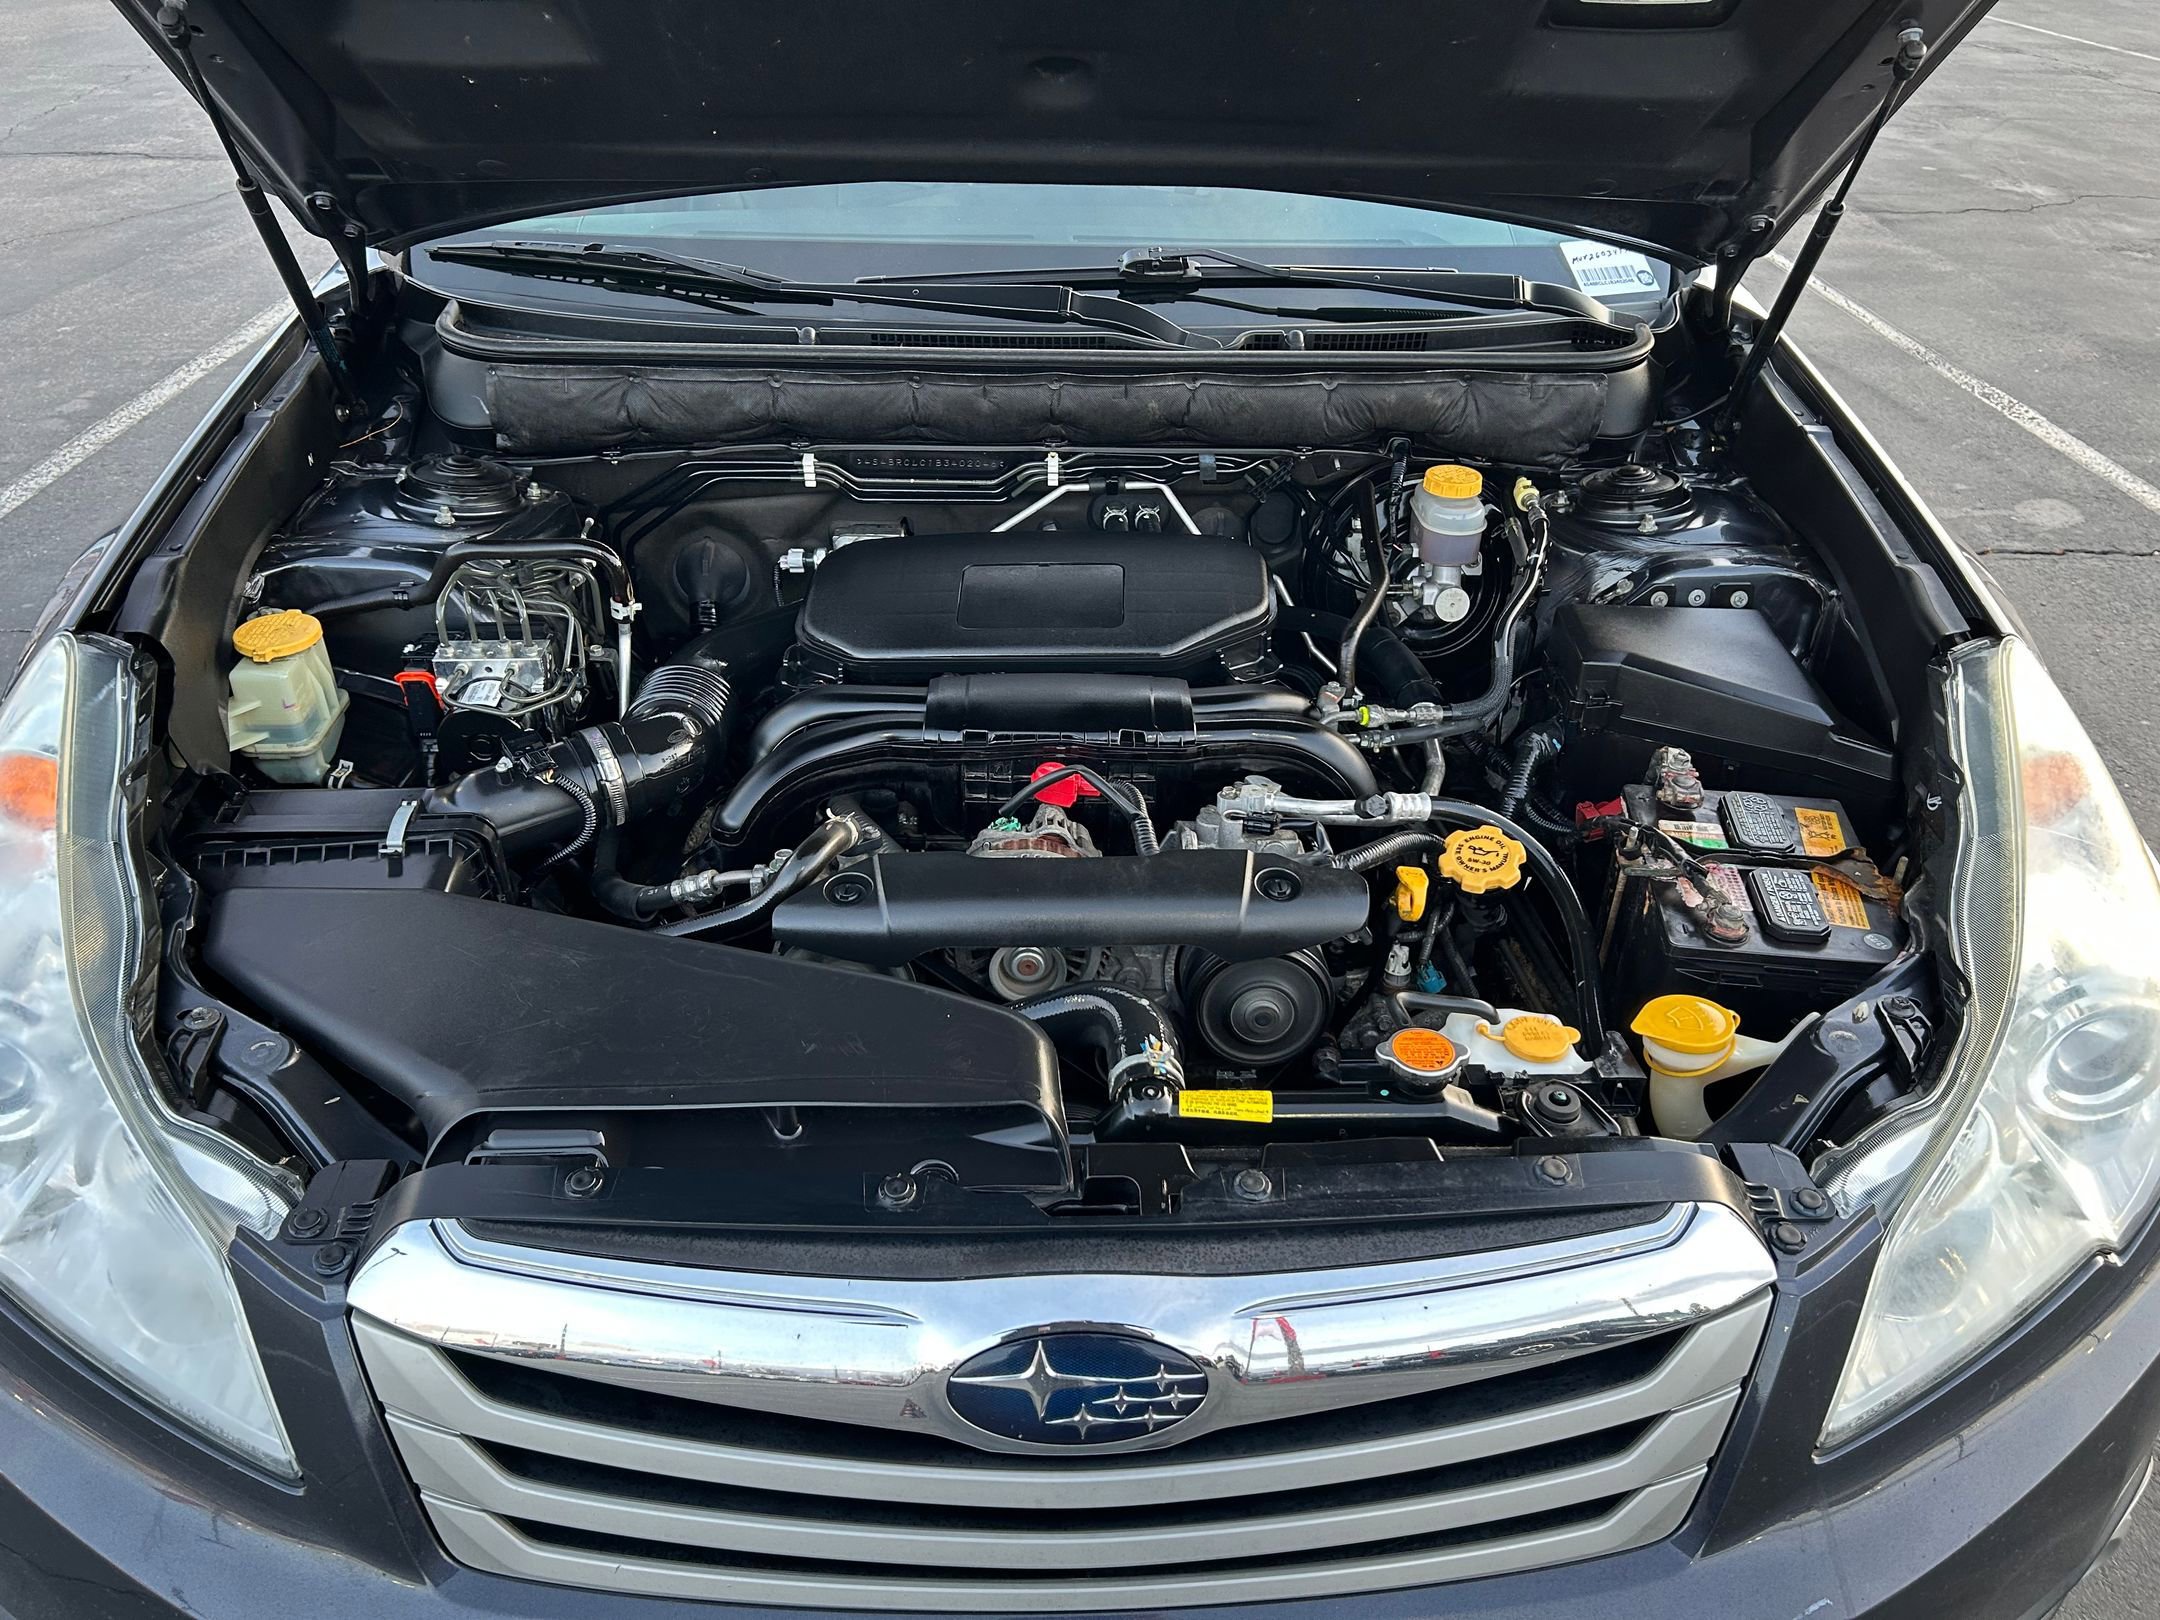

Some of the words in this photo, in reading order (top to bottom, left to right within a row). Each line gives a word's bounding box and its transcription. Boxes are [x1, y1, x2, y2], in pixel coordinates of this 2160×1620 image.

[1456, 844, 1464, 854] SEE
[1496, 840, 1506, 849] OIL
[1457, 856, 1487, 872] OWNER'S
[1489, 852, 1508, 871] MANUAL
